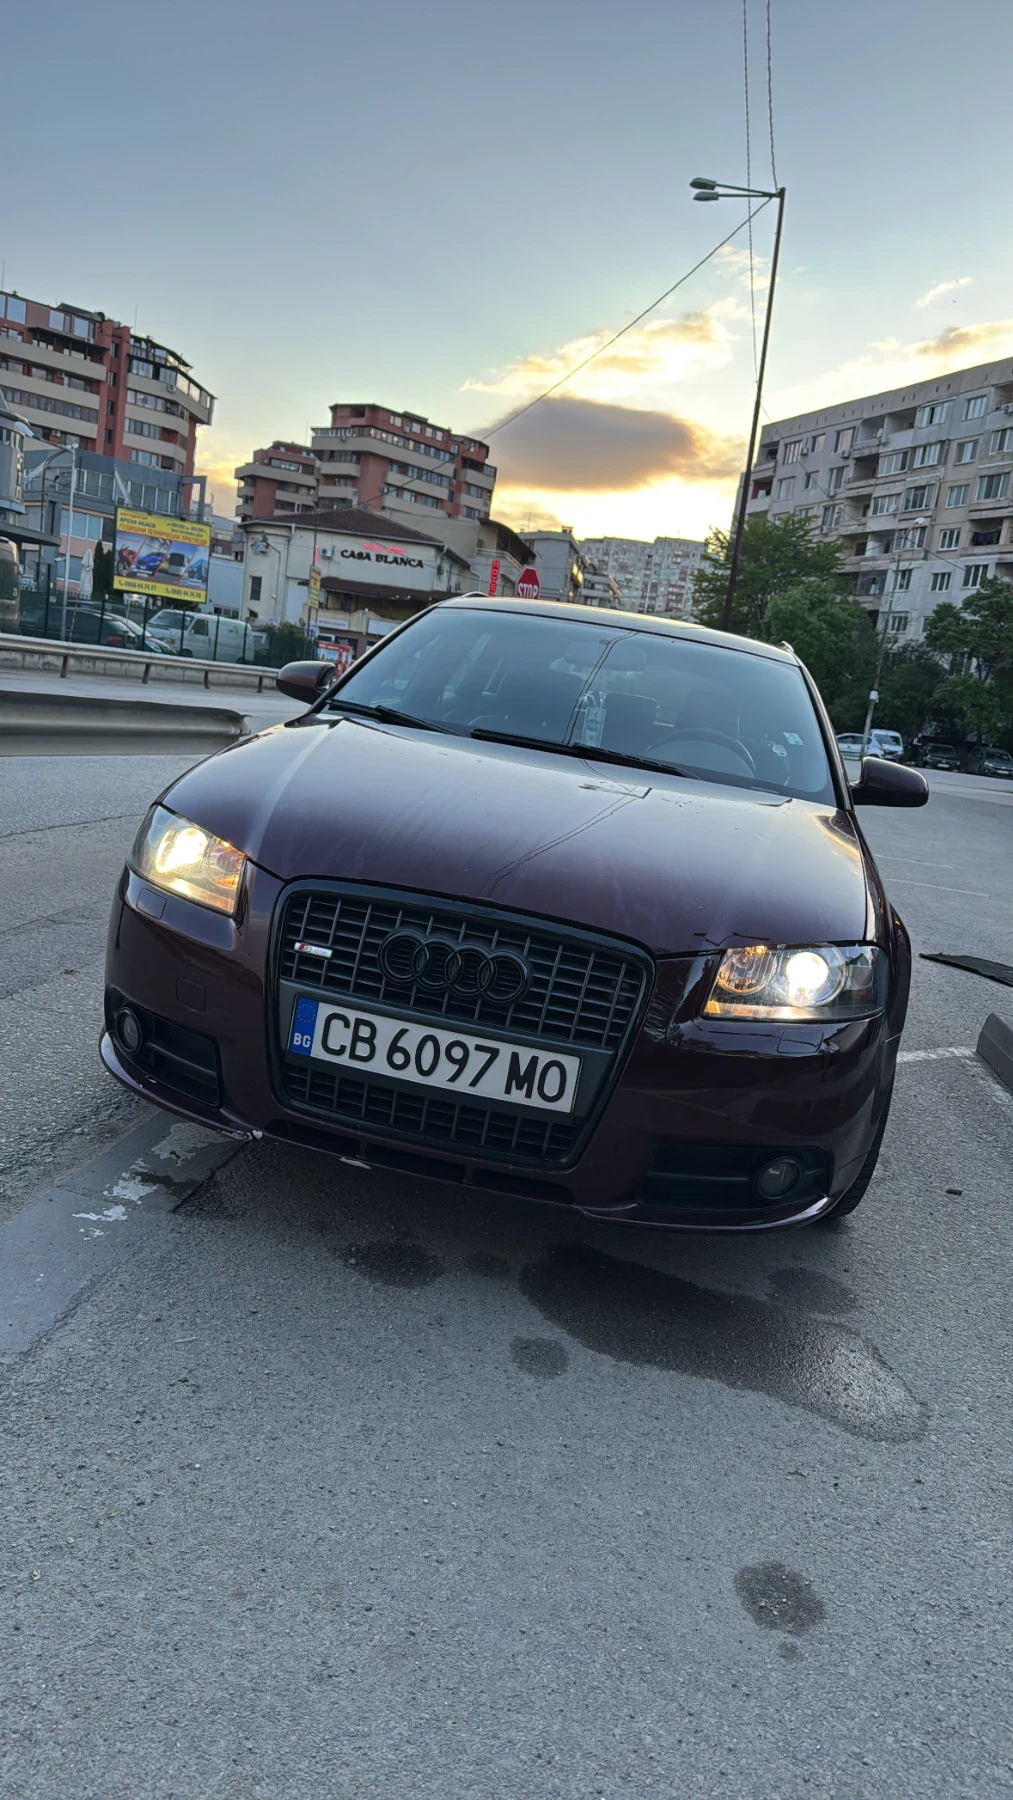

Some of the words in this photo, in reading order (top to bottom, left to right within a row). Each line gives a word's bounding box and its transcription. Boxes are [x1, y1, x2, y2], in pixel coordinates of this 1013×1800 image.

[341, 549, 372, 562] CASA
[375, 553, 424, 569] BLANCA
[517, 582, 539, 599] STOP
[292, 1032, 311, 1048] BG
[320, 1012, 377, 1063] CB
[386, 1028, 500, 1088] 6097
[504, 1051, 567, 1103] MO
